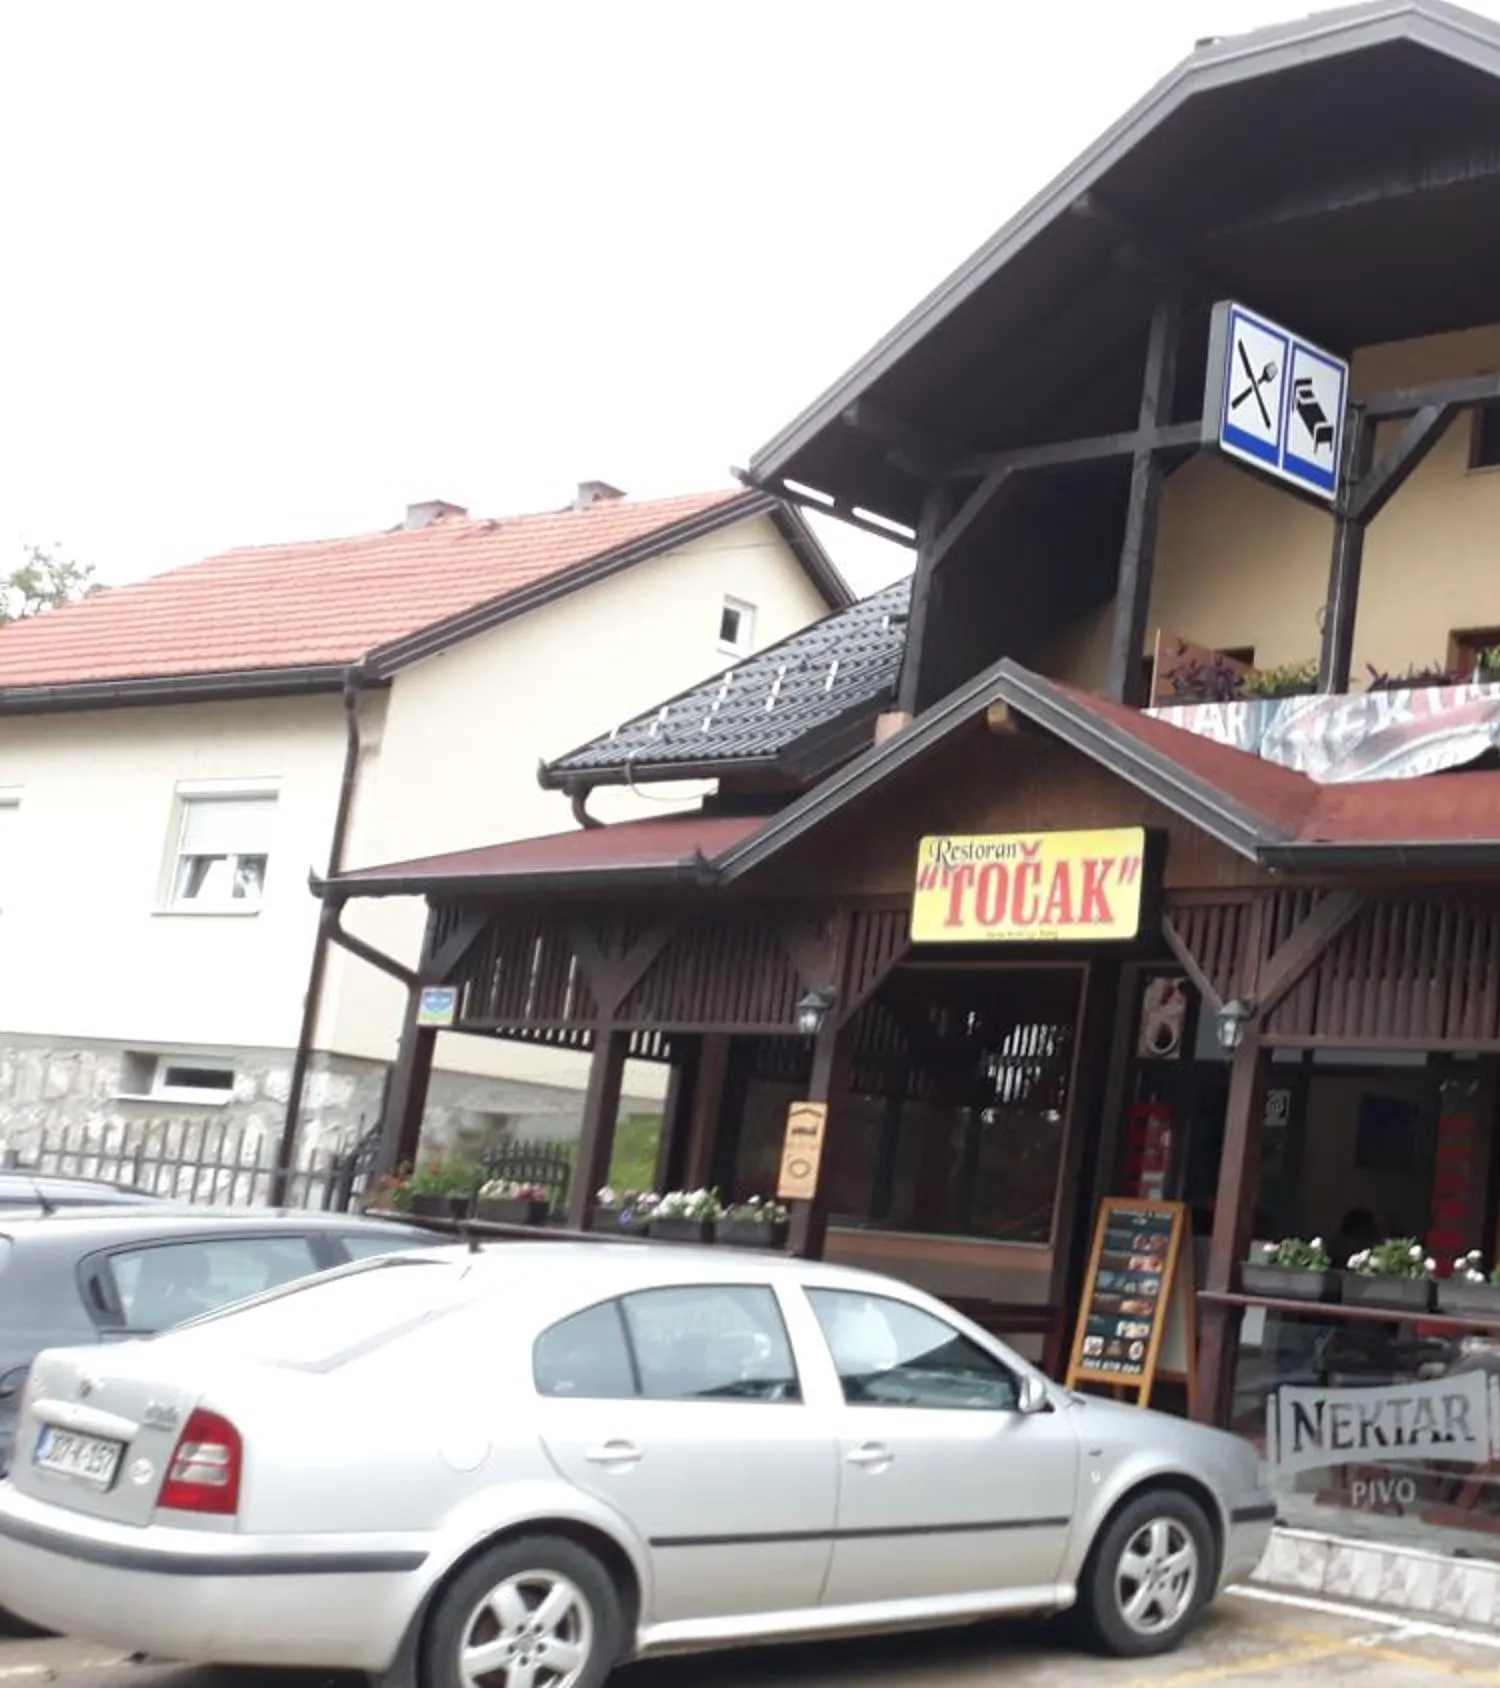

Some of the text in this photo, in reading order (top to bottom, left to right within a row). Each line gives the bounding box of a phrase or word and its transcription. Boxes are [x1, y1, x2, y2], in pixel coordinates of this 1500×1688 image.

[929, 838, 1017, 866] Restoran
[1290, 1394, 1476, 1453] NEKTAR
[1352, 1478, 1416, 1505] PIVO
